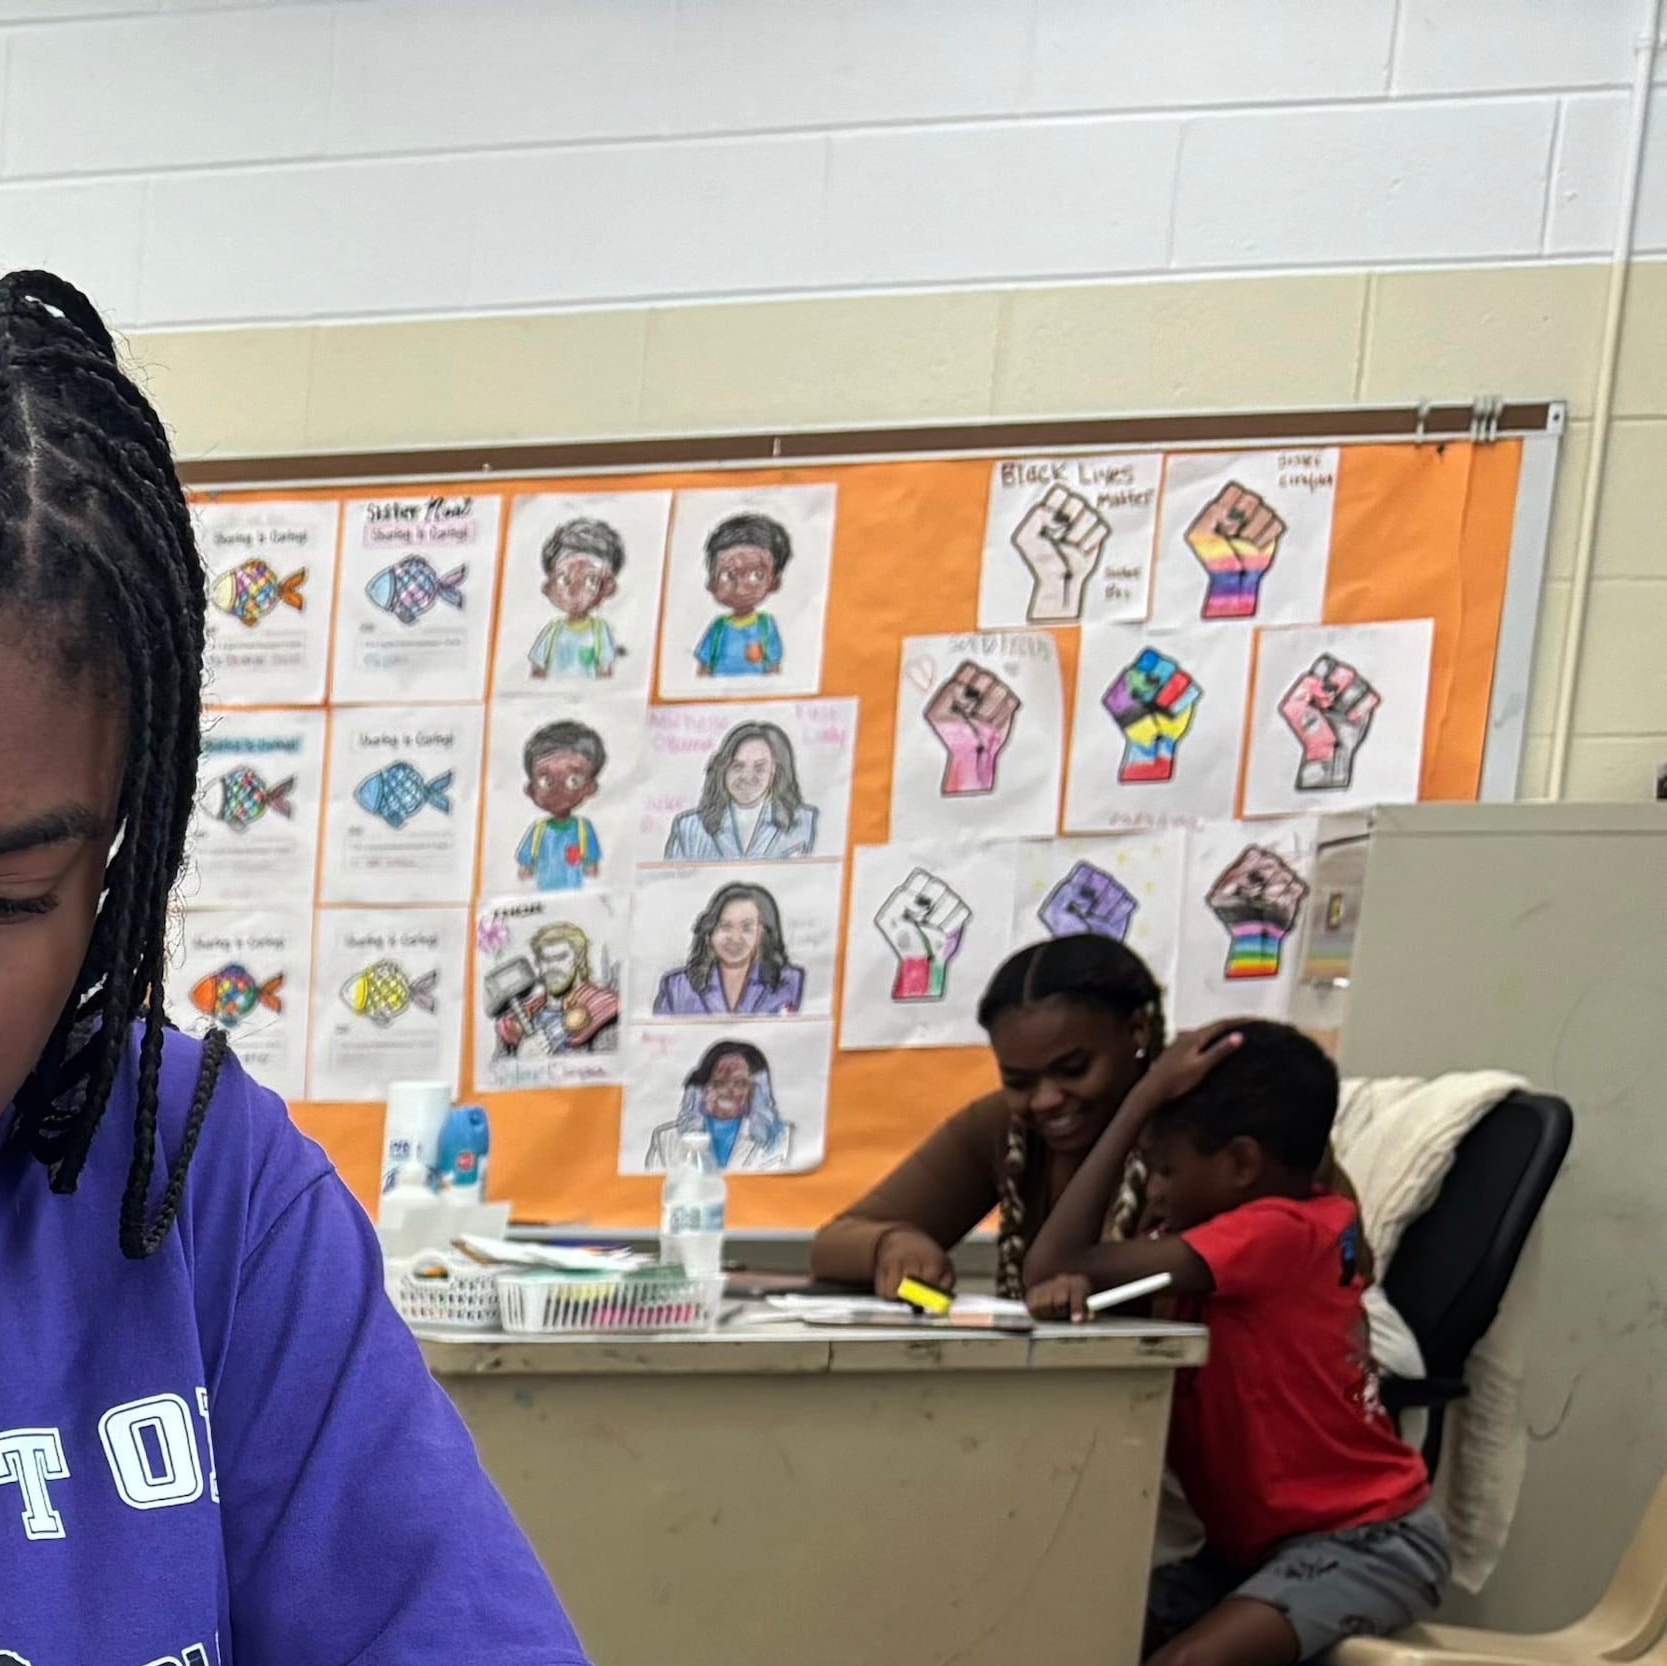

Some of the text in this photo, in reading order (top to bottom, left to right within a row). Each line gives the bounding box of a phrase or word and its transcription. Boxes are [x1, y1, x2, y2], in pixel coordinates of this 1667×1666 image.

[1000, 461, 1134, 488] Black Lives
[97, 1386, 221, 1511] O
